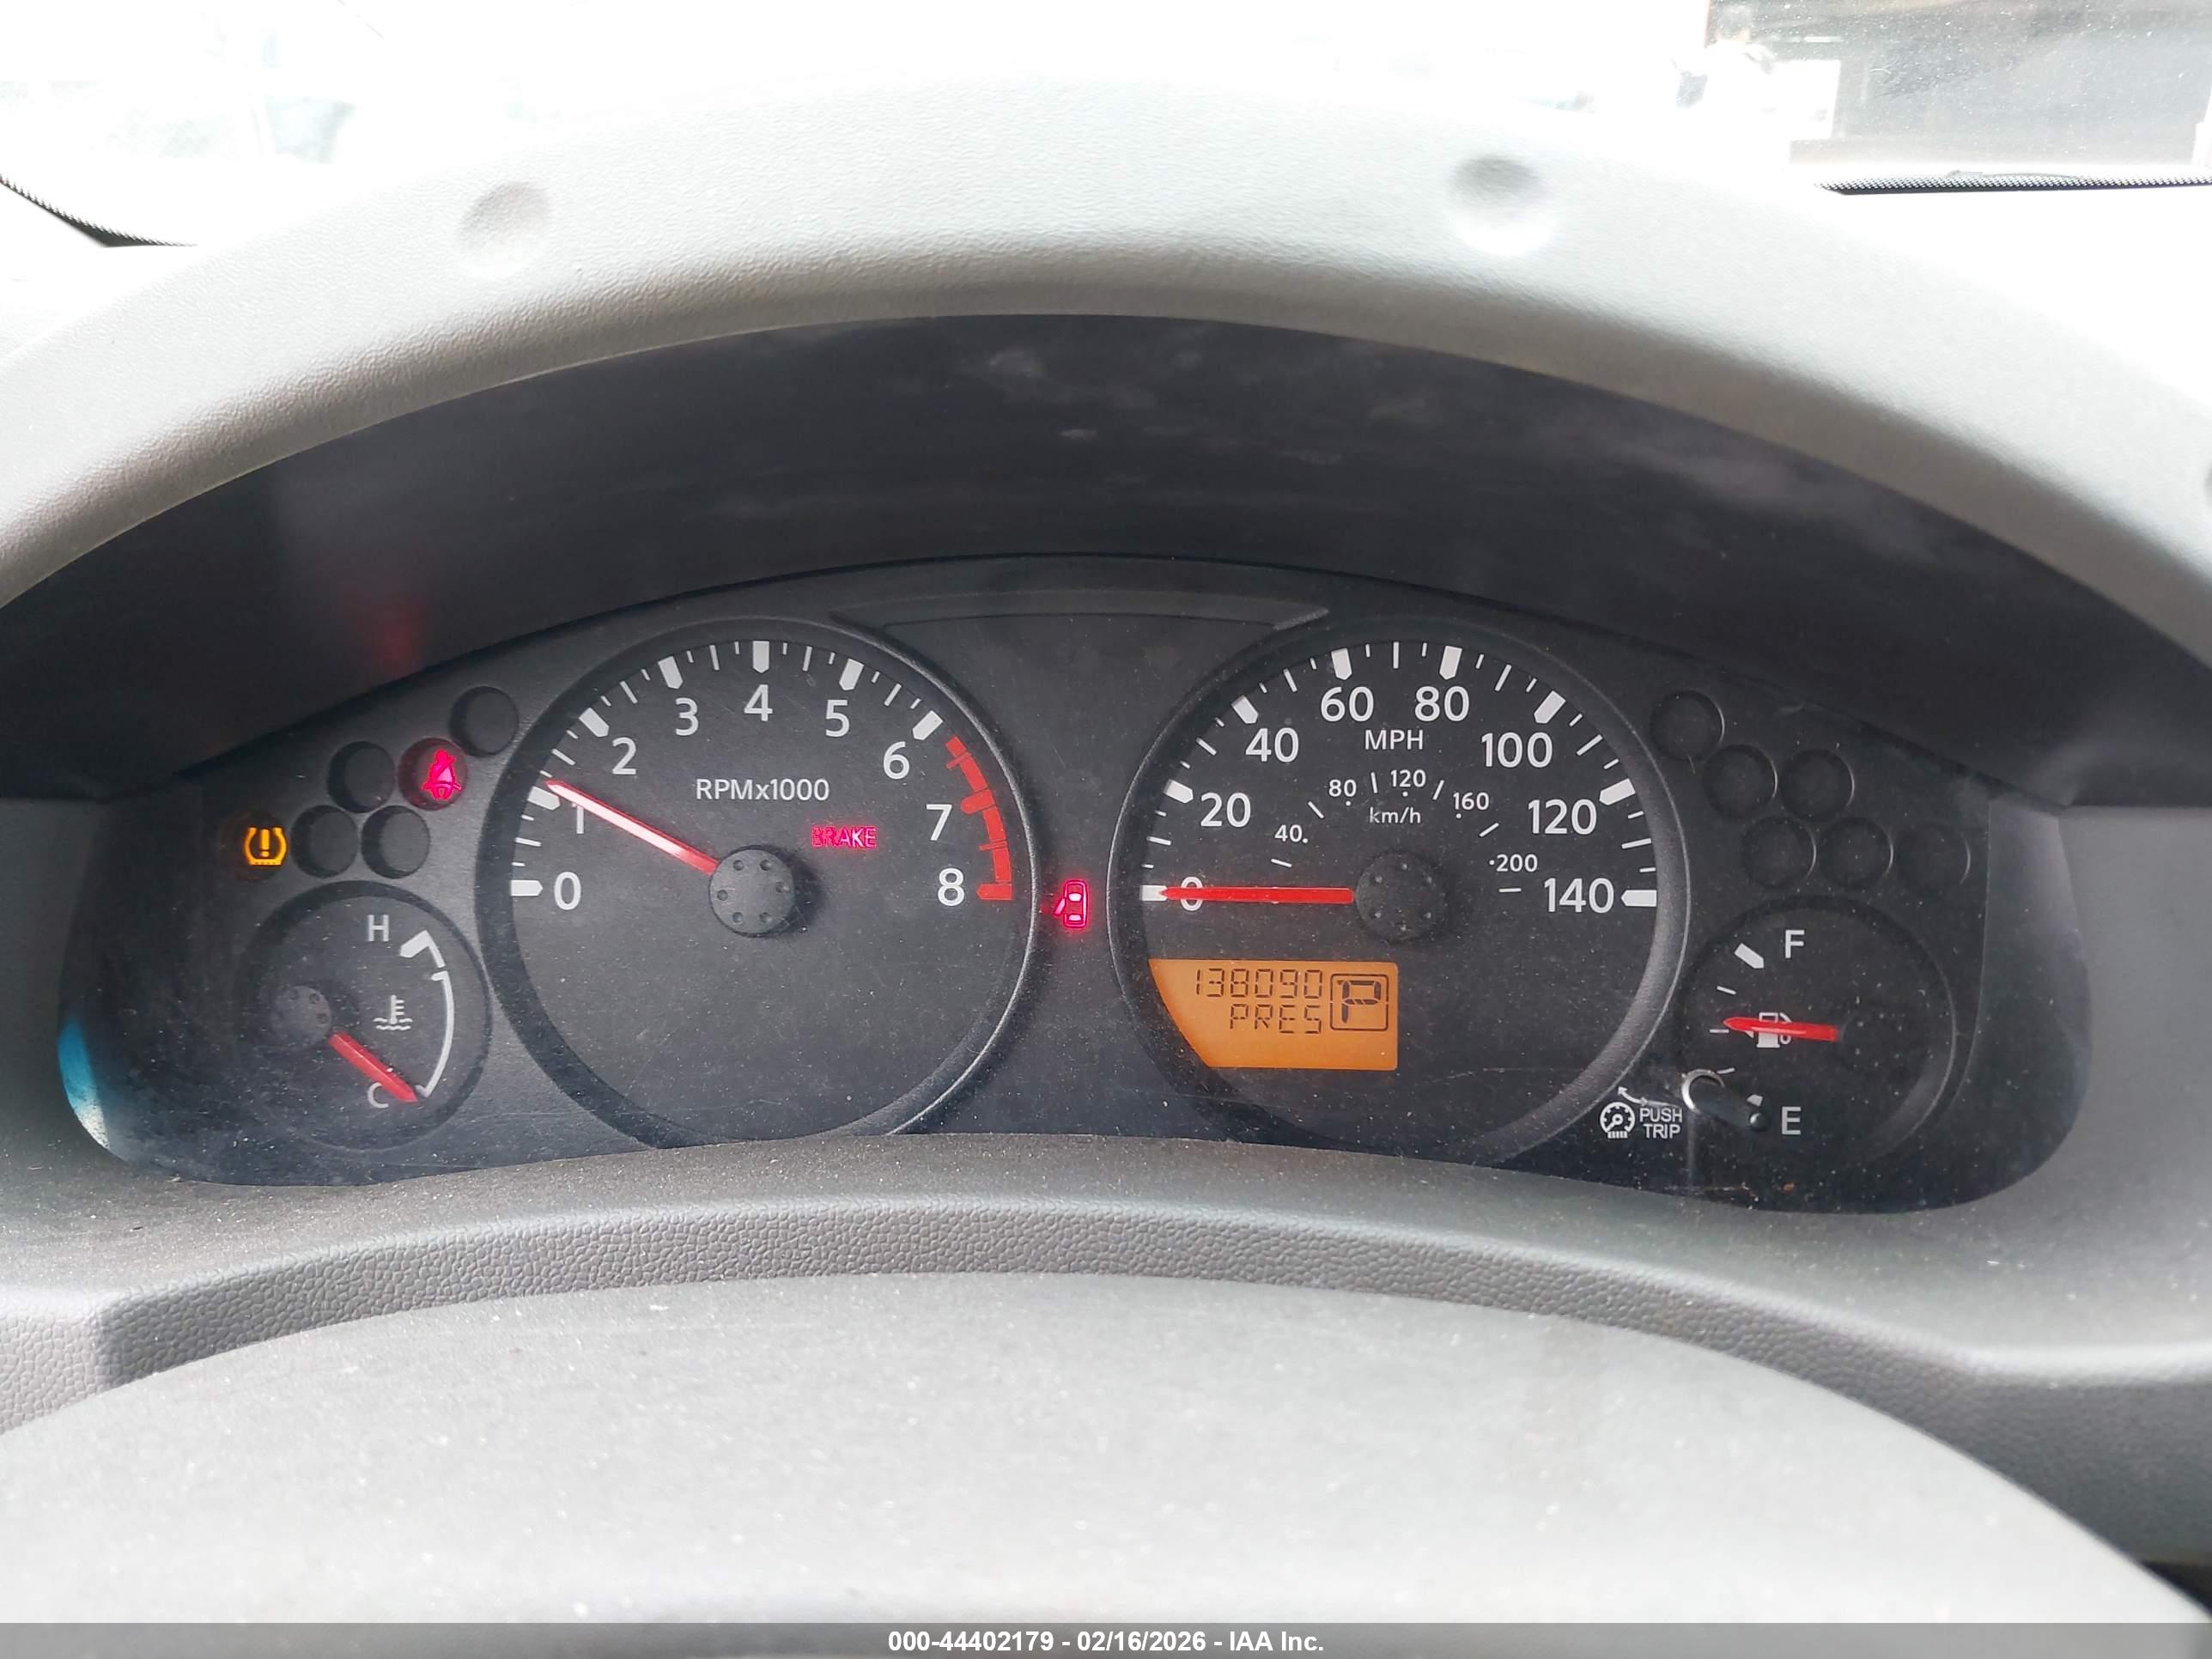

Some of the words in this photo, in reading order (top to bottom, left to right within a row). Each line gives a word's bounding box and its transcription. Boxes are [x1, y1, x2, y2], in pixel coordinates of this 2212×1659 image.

[676, 698, 699, 736] 3
[744, 684, 773, 722] 4
[826, 699, 850, 738] 5
[1321, 686, 1374, 722] 60
[1414, 686, 1469, 722] 80
[611, 737, 637, 775] 2
[1246, 728, 1299, 763] 40
[1365, 730, 1424, 750] MPH
[1481, 732, 1553, 768] 100
[883, 742, 910, 780] 6
[696, 778, 830, 801] RPMx1000
[1328, 779, 1357, 797] 80
[1390, 770, 1426, 787] 120
[1200, 792, 1251, 828] 20
[1369, 805, 1421, 824] km/h
[1453, 792, 1489, 811] 160
[1528, 799, 1597, 835] 120
[811, 825, 878, 848] BRAKE
[926, 804, 952, 841] 7
[1274, 824, 1302, 843] 40
[1496, 854, 1538, 872] 200
[554, 872, 581, 910] 0
[938, 868, 965, 907] 8
[1544, 878, 1614, 914] 140
[368, 915, 389, 942] H
[1784, 929, 1805, 958] F
[1196, 968, 1323, 1000] 138090
[1337, 979, 1382, 1024] P
[1230, 1003, 1322, 1034] PRES
[368, 1083, 389, 1109] C
[1639, 1108, 1682, 1123] PUSH
[1643, 1123, 1680, 1139] TRIP
[1781, 1106, 1802, 1135] E
